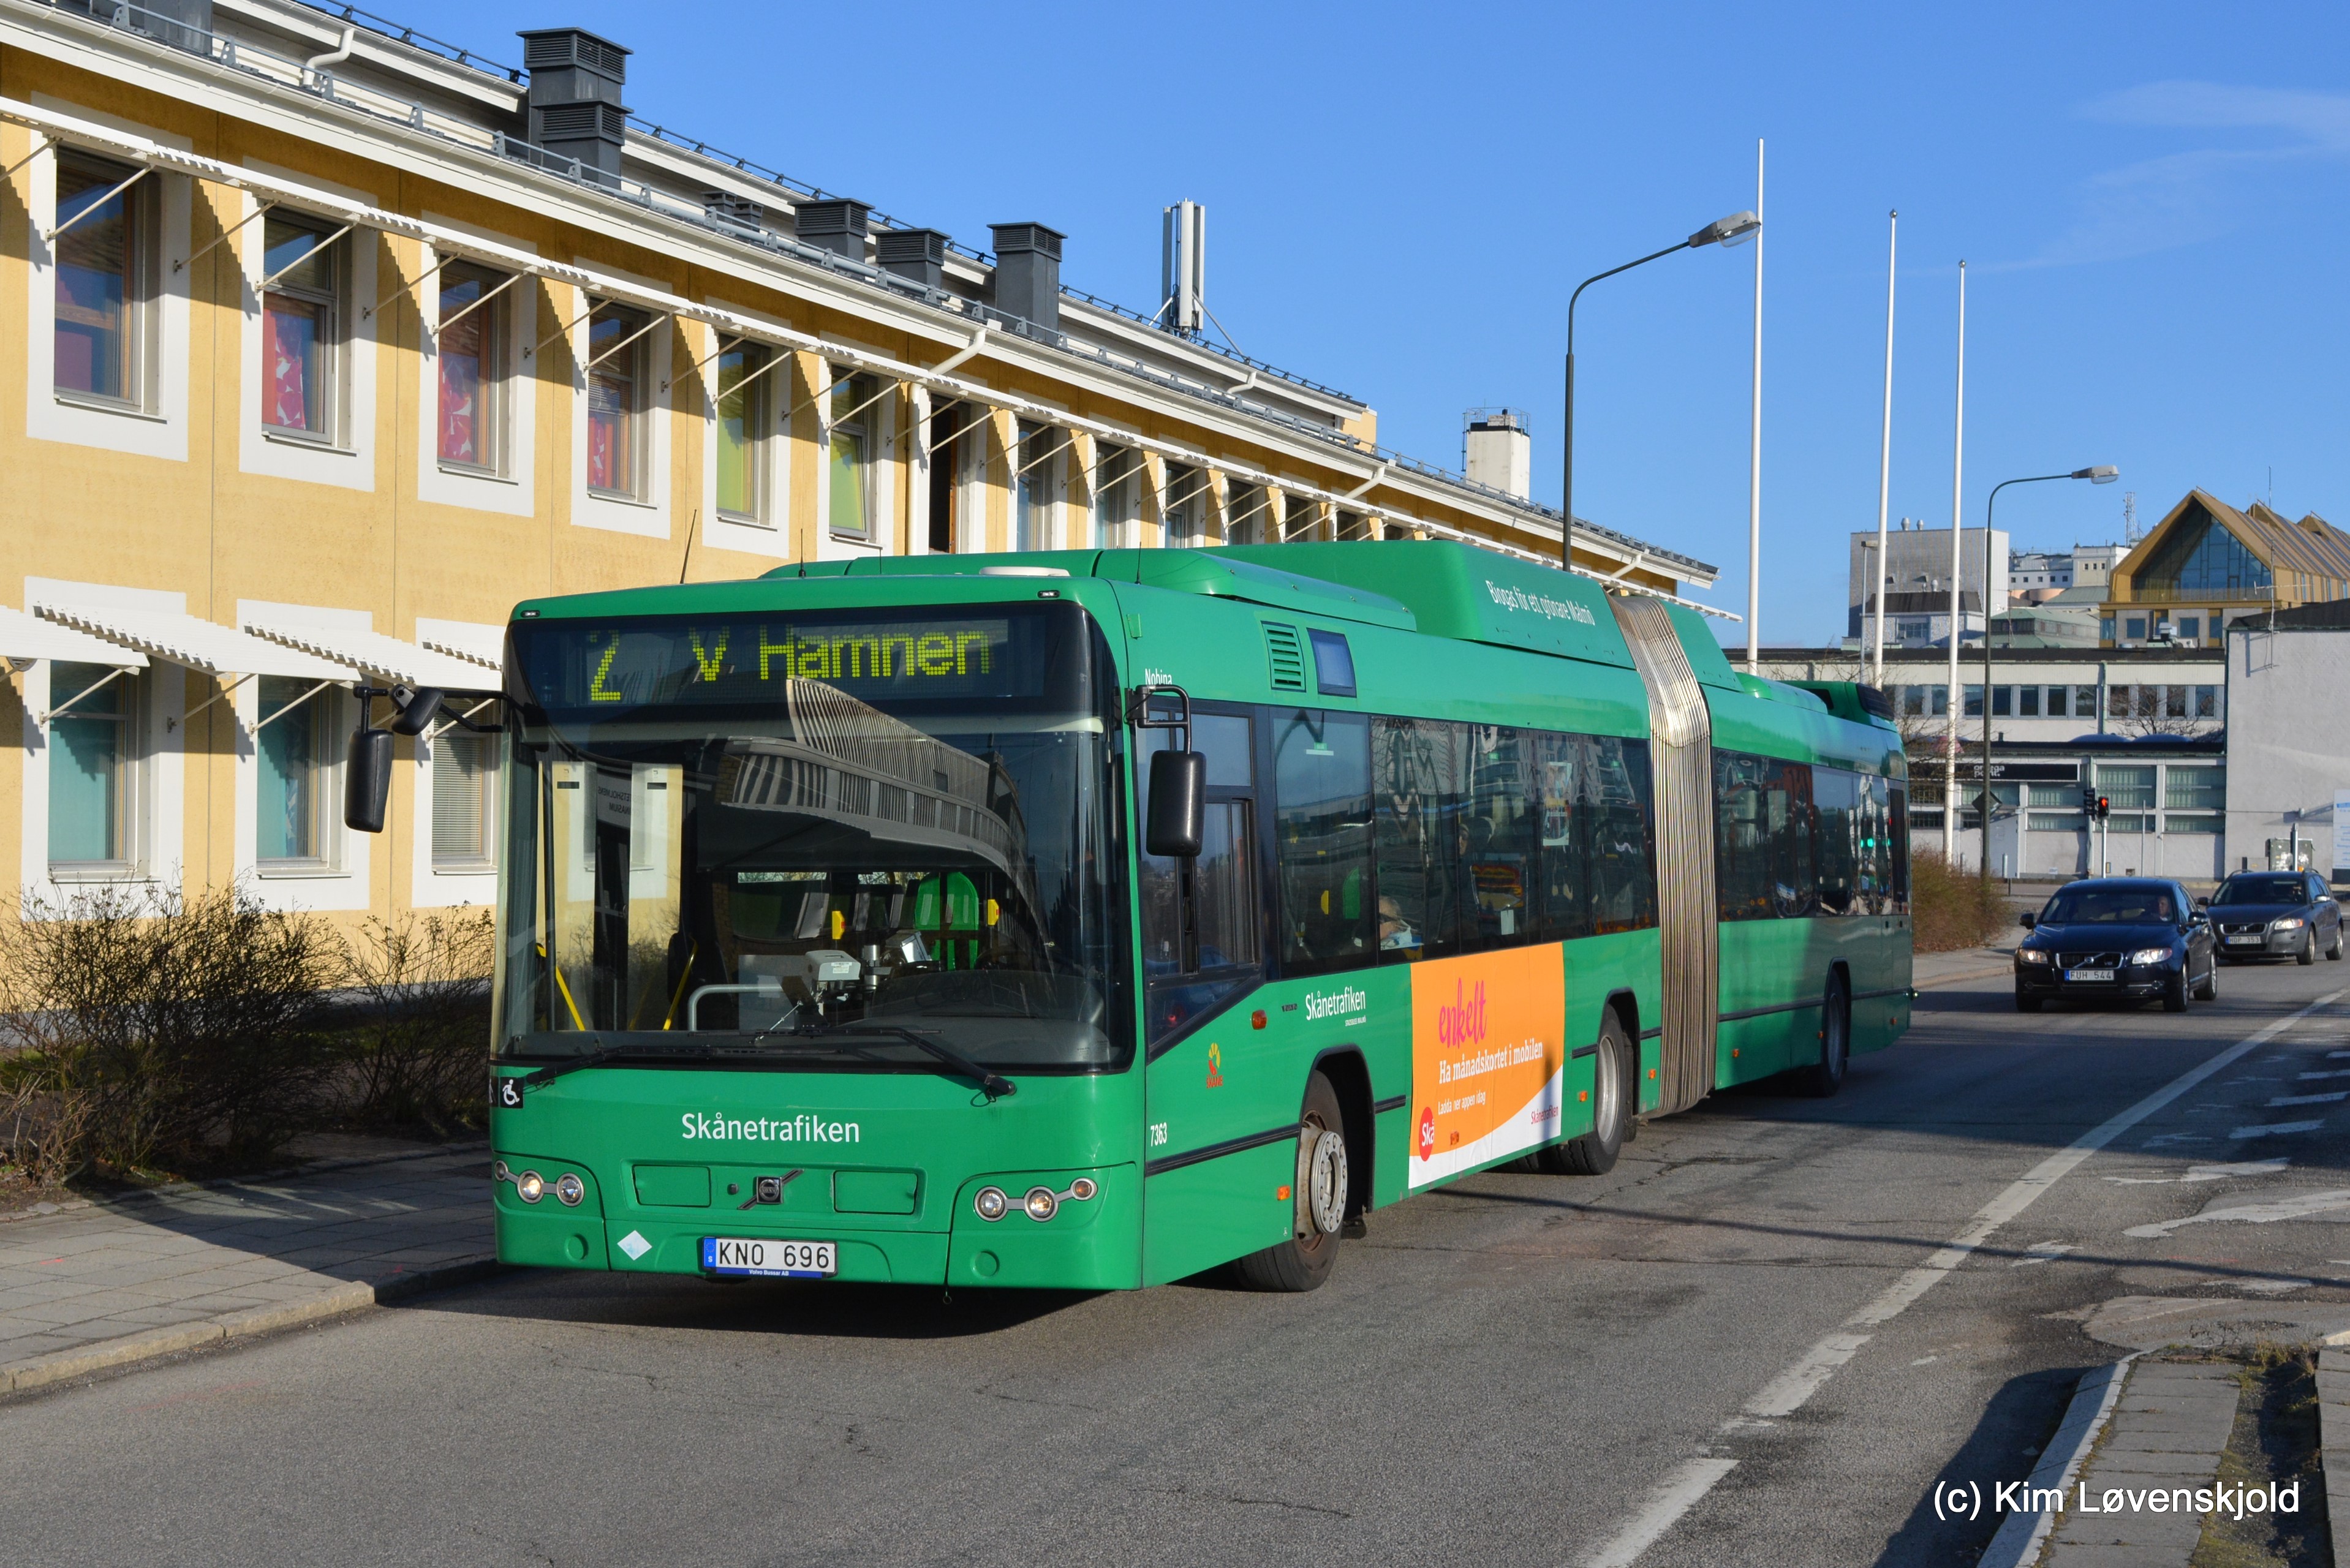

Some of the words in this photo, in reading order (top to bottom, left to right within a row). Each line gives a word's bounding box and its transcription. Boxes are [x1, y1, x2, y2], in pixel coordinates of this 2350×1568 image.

[1486, 580, 1519, 612] Biogas
[1513, 586, 1530, 611] för
[1528, 593, 1543, 614] ett
[1540, 595, 1570, 620] grönare
[1566, 600, 1595, 626] Malmö
[591, 629, 621, 701] 2
[759, 624, 989, 680] Hamnen
[1145, 668, 1173, 685] Nobina
[1305, 986, 1366, 1021] Skånetrafiken
[1439, 977, 1487, 1049] enkelt
[1439, 1060, 1451, 1084] Ha
[1453, 1046, 1508, 1080] månadskortet
[1509, 1044, 1513, 1063] i
[1513, 1038, 1543, 1065] mobilen
[1438, 1098, 1452, 1115] Ladda
[1462, 1095, 1476, 1111] appen
[1531, 1105, 1558, 1125] Skånetrafiken
[682, 1112, 860, 1143] Skånetrafiken
[1150, 1122, 1168, 1147] 7363
[719, 1242, 764, 1266] KNO
[784, 1245, 829, 1268] 696
